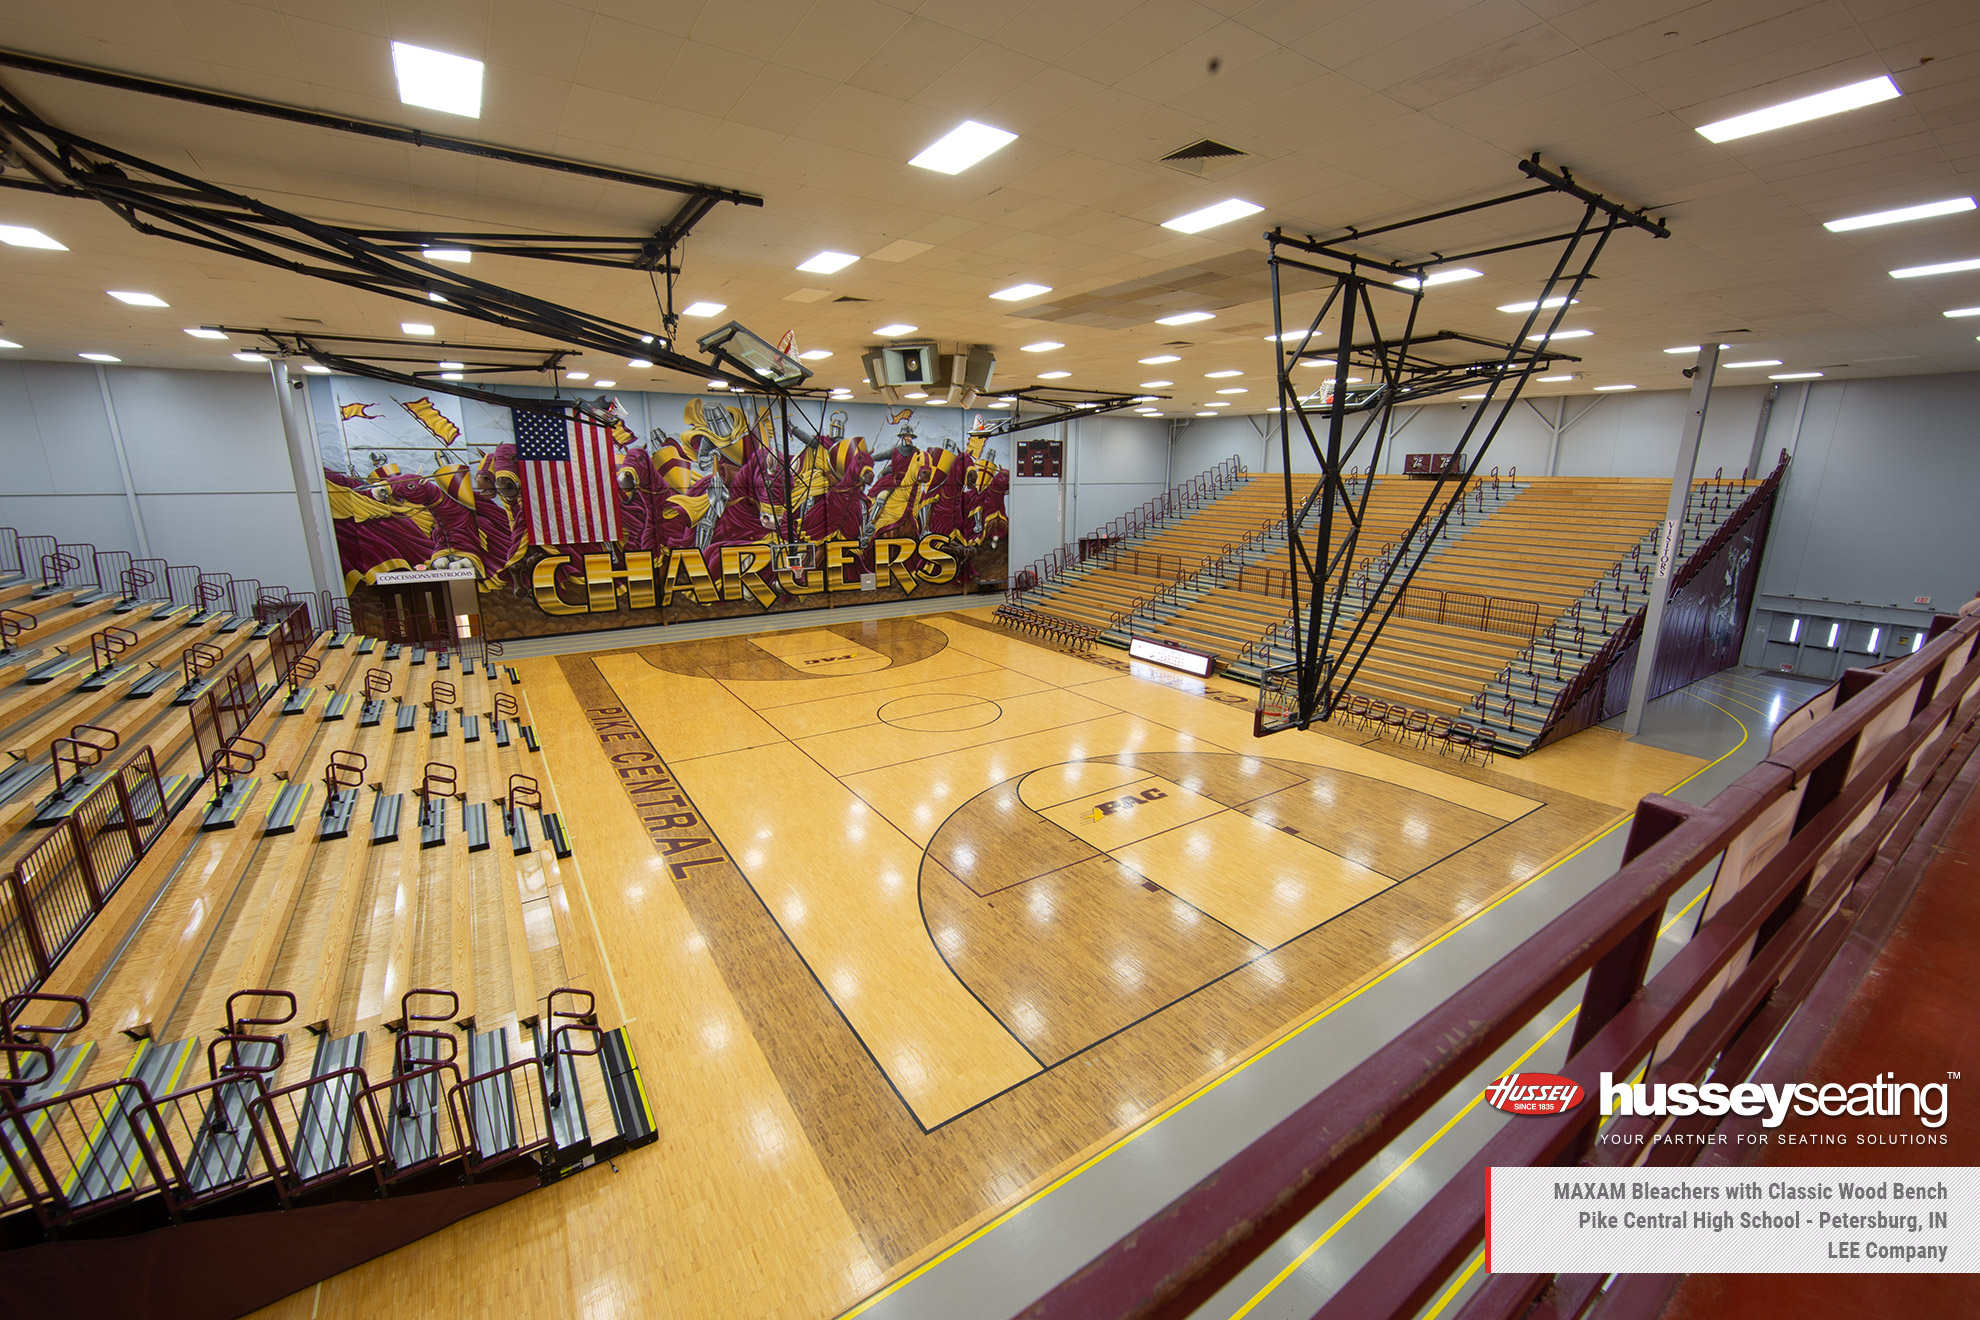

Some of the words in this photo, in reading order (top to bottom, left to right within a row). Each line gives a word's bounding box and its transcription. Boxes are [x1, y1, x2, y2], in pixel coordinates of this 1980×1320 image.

[1659, 521, 1675, 576] VISITORS
[379, 571, 473, 581] CONCESSIONS/RESTROOMS
[531, 533, 960, 616] CHARGERS
[585, 706, 644, 744] PIKE
[609, 751, 729, 882] CENTRAL
[1094, 787, 1169, 815] PAC
